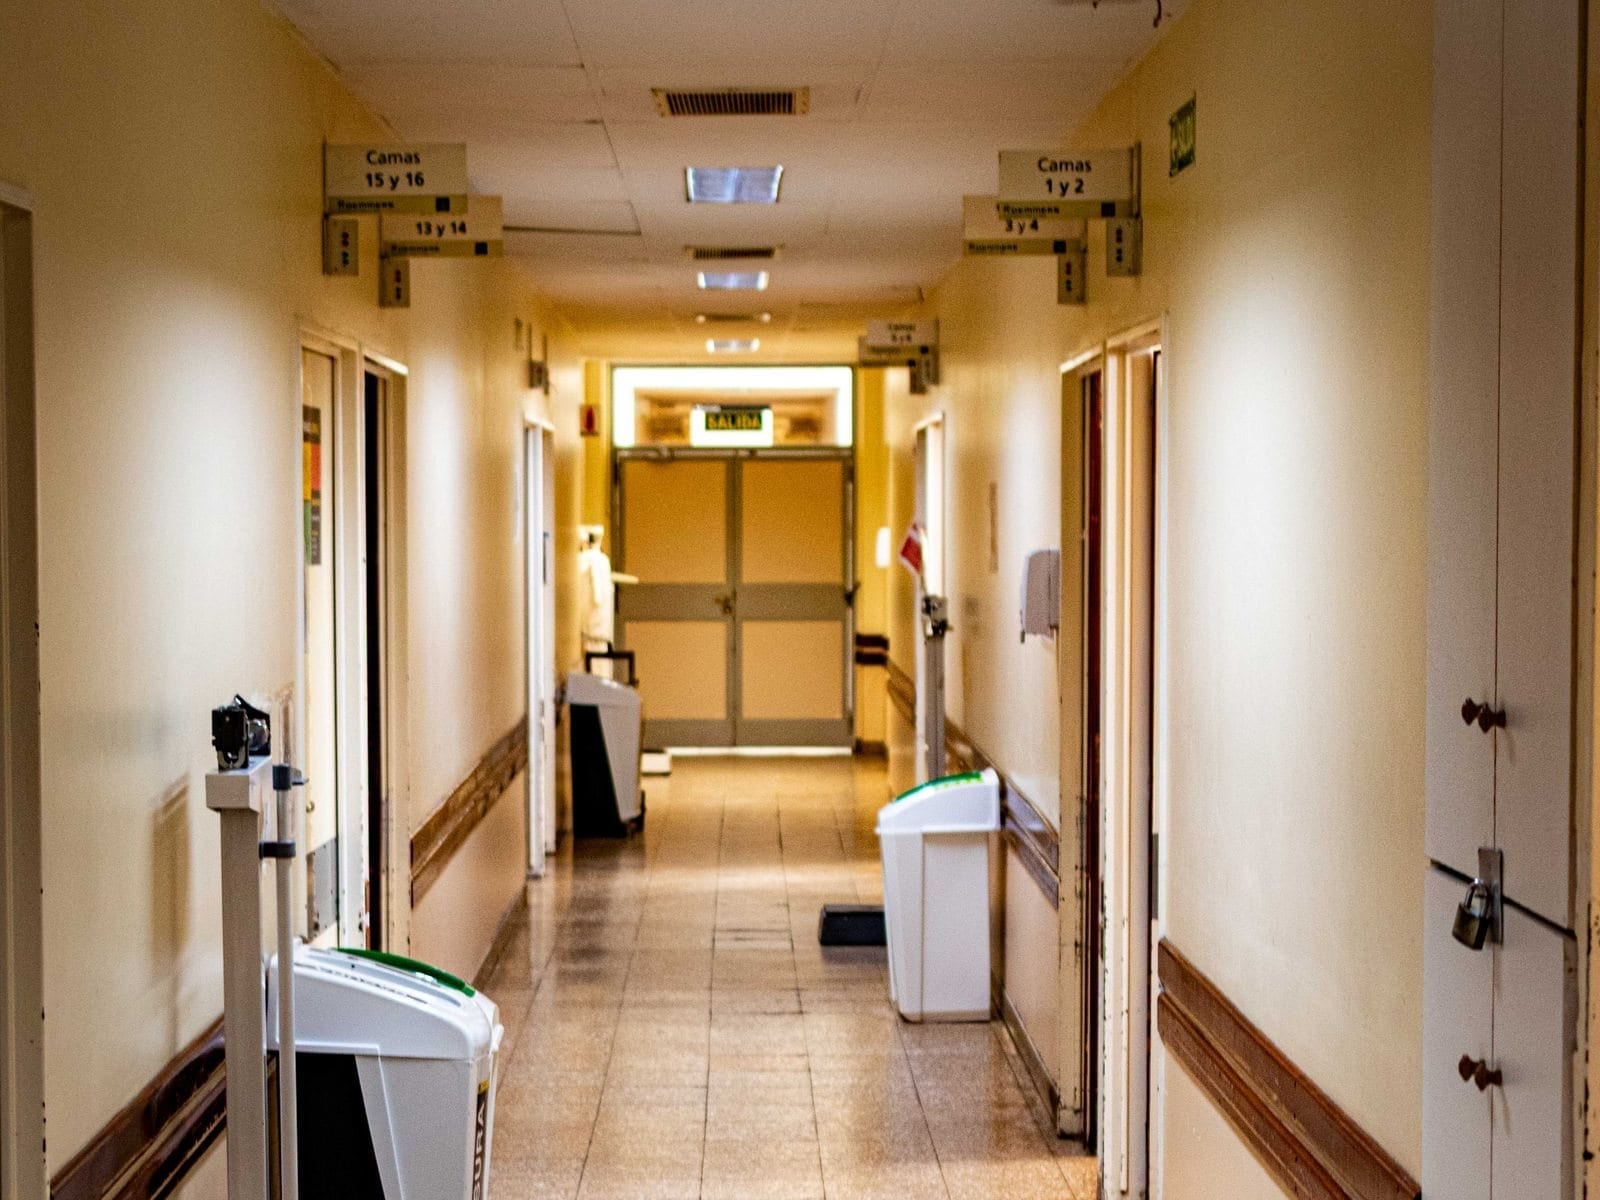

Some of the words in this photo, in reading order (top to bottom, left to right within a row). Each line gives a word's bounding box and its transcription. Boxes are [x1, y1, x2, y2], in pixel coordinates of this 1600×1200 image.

[366, 150, 421, 165] Camas
[1038, 157, 1092, 172] Camas
[366, 172, 384, 187] 15
[390, 176, 399, 190] y
[406, 172, 425, 187] 16
[1046, 179, 1053, 193] 1
[1060, 182, 1069, 197] y
[1075, 179, 1084, 193] 2
[416, 222, 432, 235] 13
[437, 225, 445, 237] y
[451, 221, 466, 234] 14
[1018, 221, 1026, 234] y
[1031, 219, 1039, 231] 4
[707, 412, 760, 429] SALIDA
